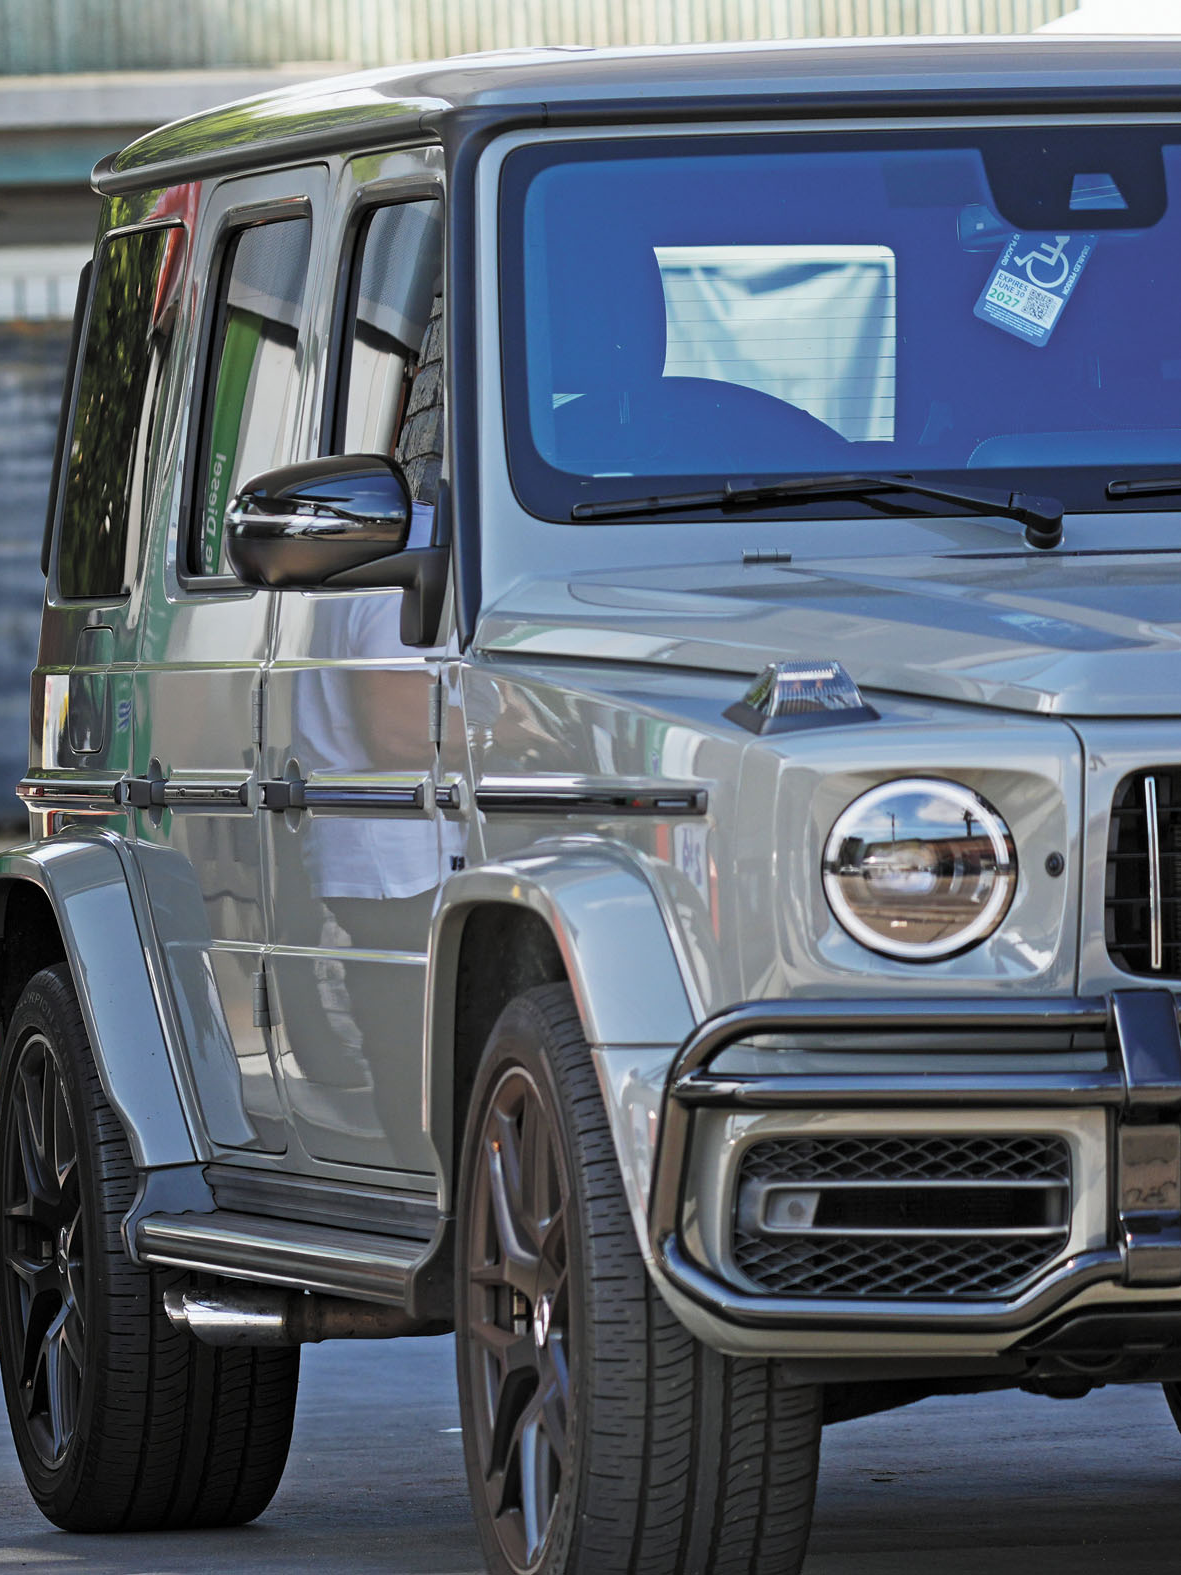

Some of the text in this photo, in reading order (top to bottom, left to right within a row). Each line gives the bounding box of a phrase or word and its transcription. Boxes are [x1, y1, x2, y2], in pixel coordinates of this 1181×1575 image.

[995, 281, 1025, 298] JUNE 30
[998, 272, 1029, 292] EXPIRES
[987, 288, 1020, 308] 2027
